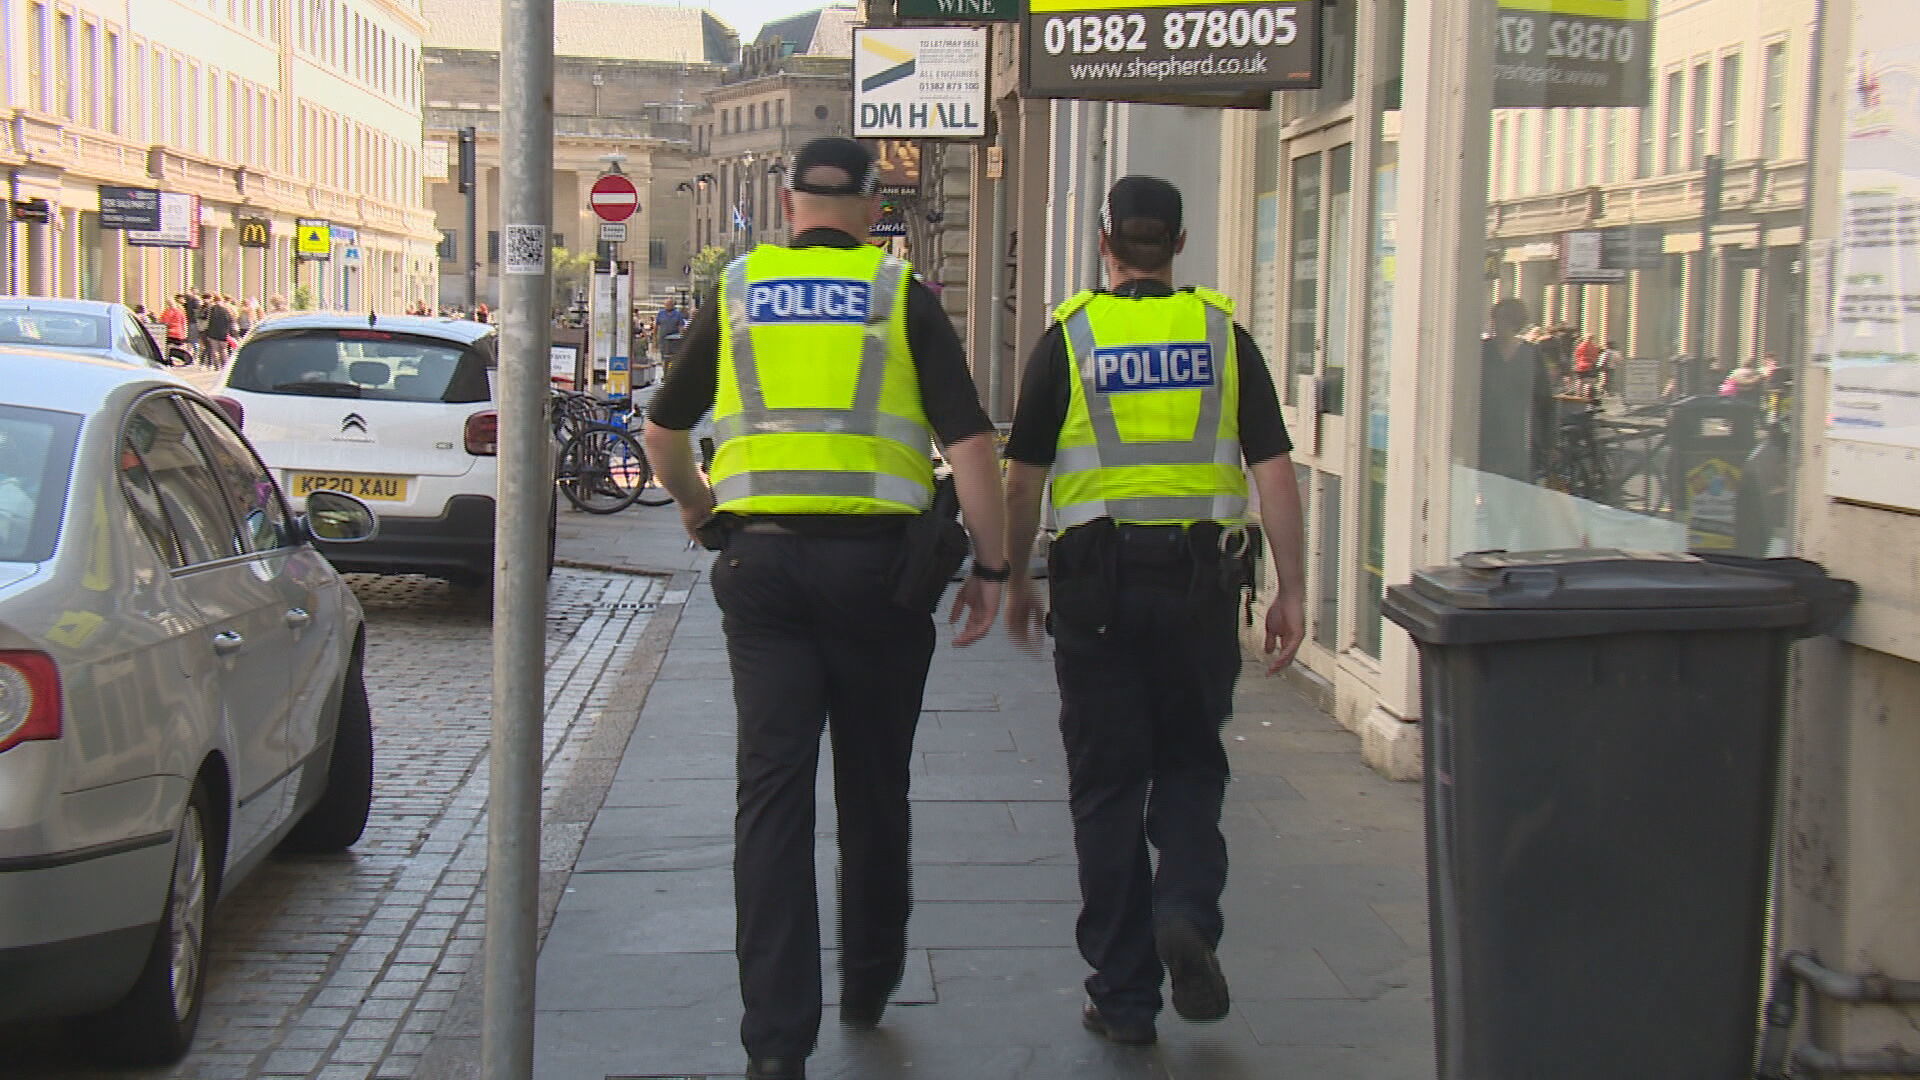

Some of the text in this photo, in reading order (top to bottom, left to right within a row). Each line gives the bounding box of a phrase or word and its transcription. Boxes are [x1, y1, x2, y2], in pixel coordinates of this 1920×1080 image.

[938, 0, 995, 14] WINE
[1044, 7, 1298, 55] 01382 878005
[1070, 51, 1268, 81] www.shepherd.co.uk
[861, 102, 979, 128] DM HALL
[750, 284, 867, 317] POLICE
[1097, 348, 1210, 386] POLICE
[359, 478, 398, 496] XAU
